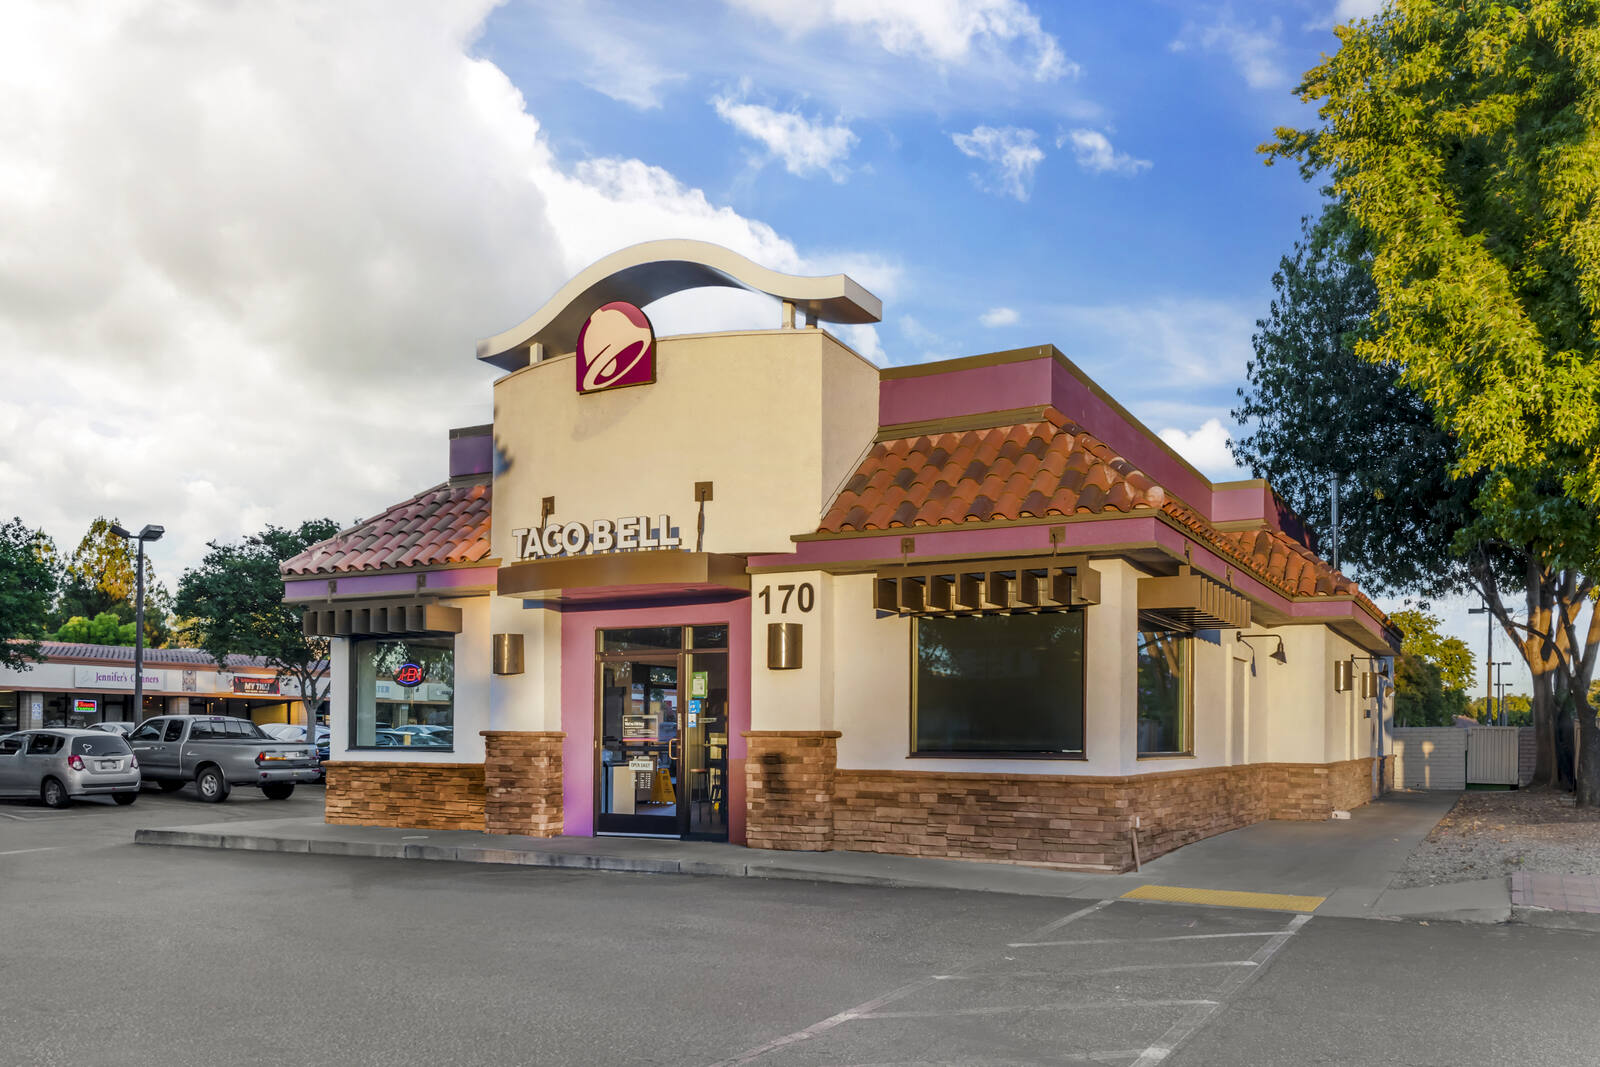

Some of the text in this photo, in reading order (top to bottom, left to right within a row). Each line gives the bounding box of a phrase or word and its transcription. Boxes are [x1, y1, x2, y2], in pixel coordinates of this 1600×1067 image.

[512, 514, 681, 558] TACO BELL
[758, 582, 815, 615] 170
[95, 671, 159, 684] Jennifer's Caners
